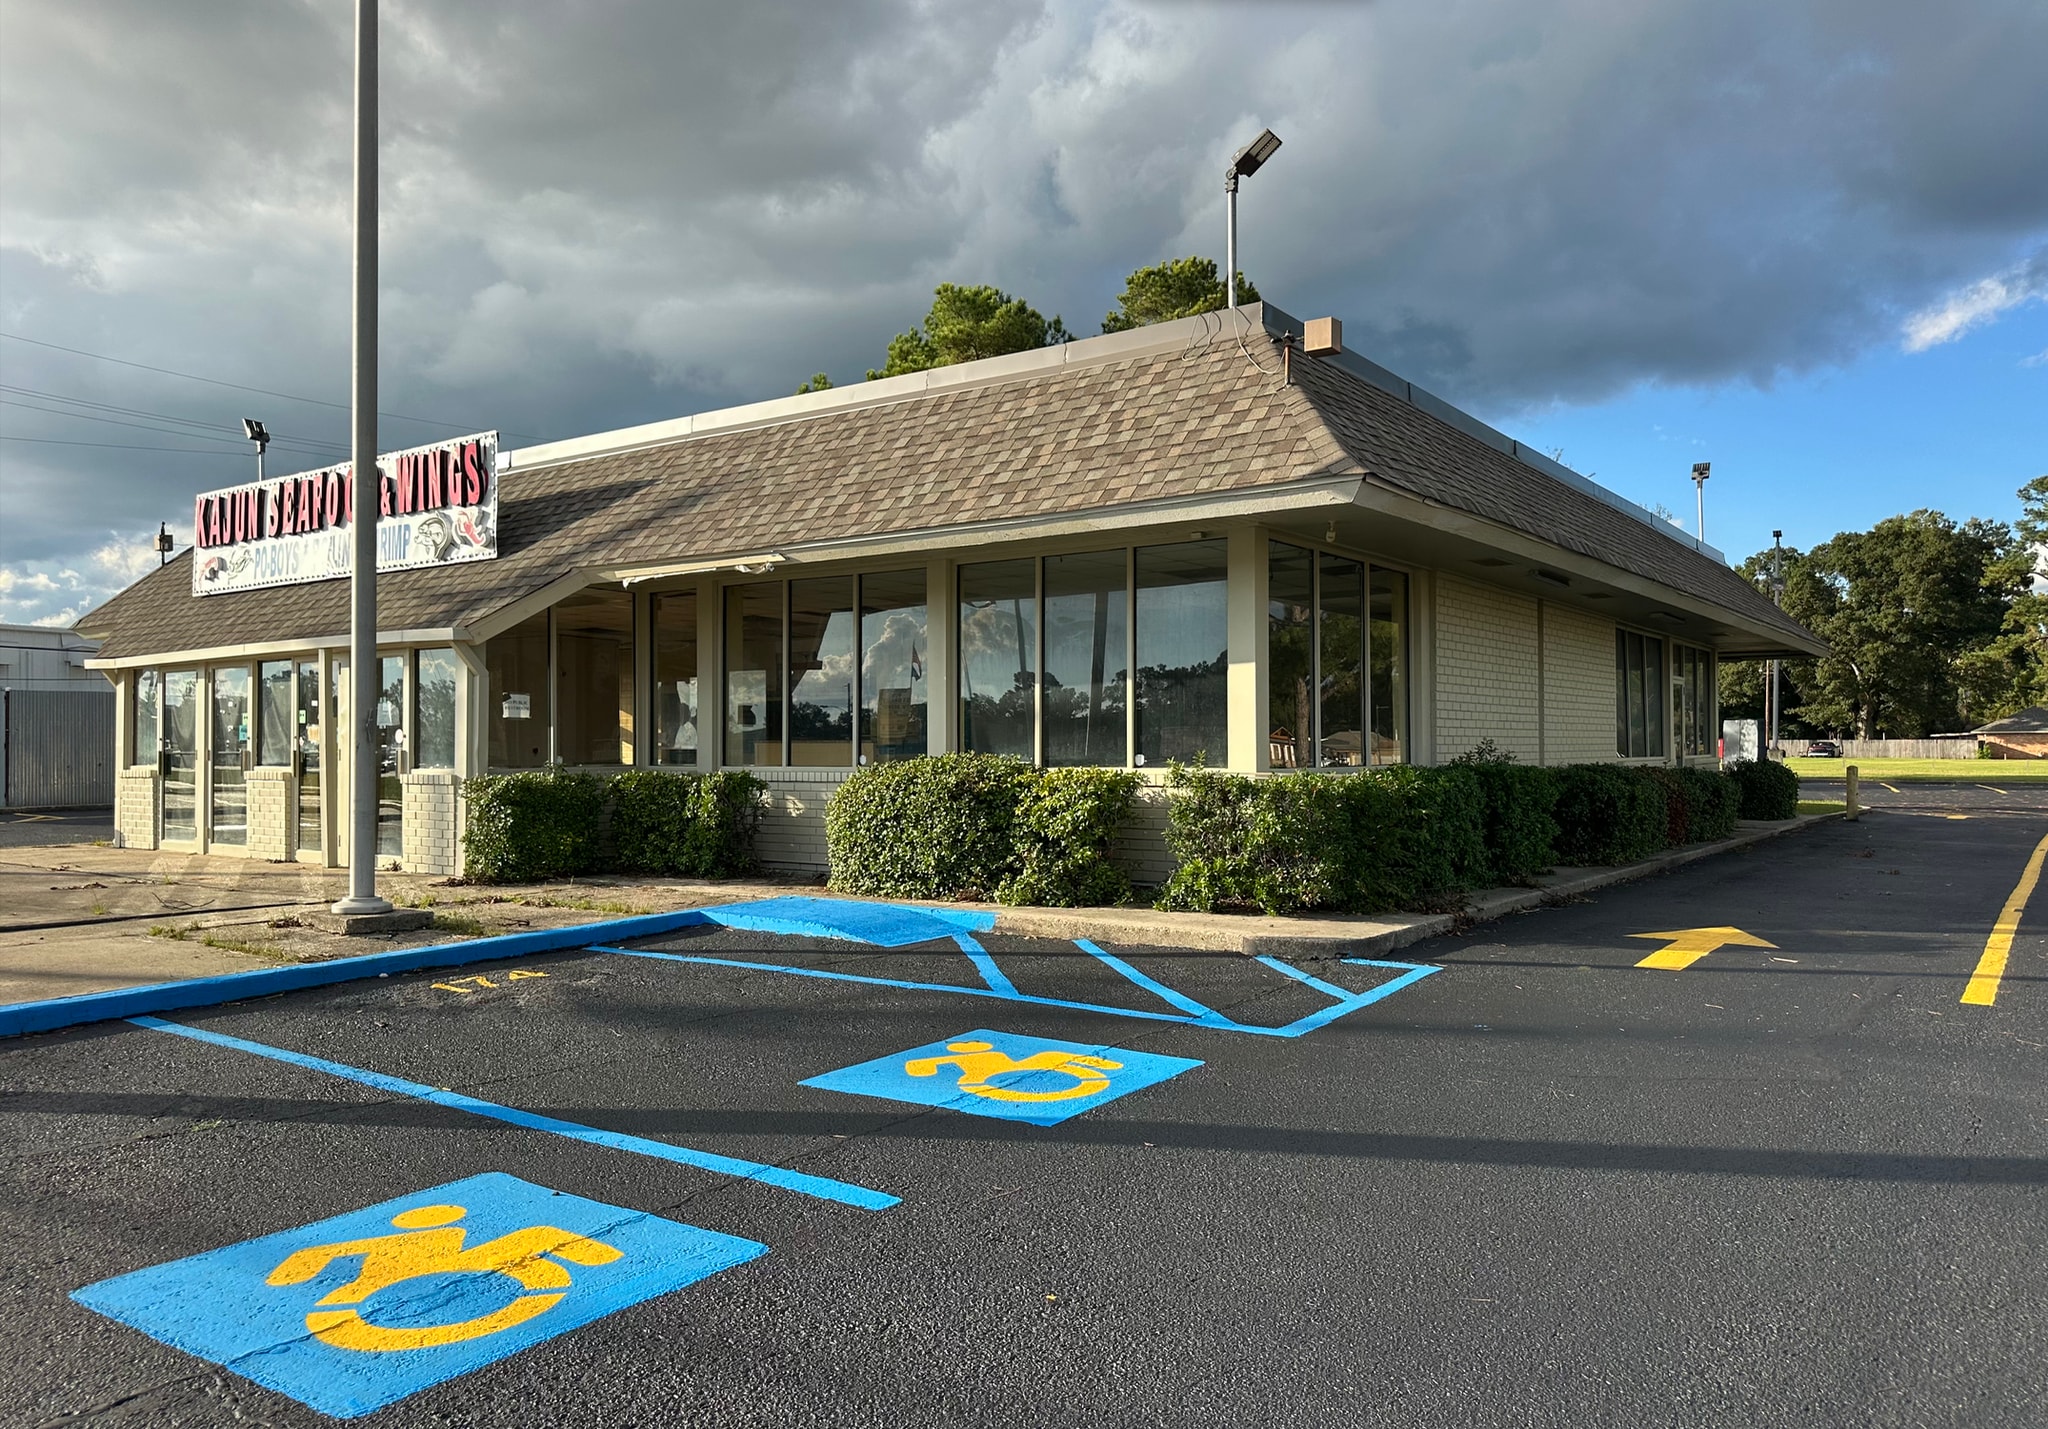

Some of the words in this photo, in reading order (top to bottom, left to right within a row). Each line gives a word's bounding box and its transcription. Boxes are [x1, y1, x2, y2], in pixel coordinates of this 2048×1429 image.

[196, 488, 261, 548] KAJUN
[268, 468, 354, 539] SEAFOO
[380, 477, 393, 517] &
[396, 442, 485, 515] WINGS
[253, 541, 301, 580] PO-BOYS
[377, 524, 411, 562] RIMP
